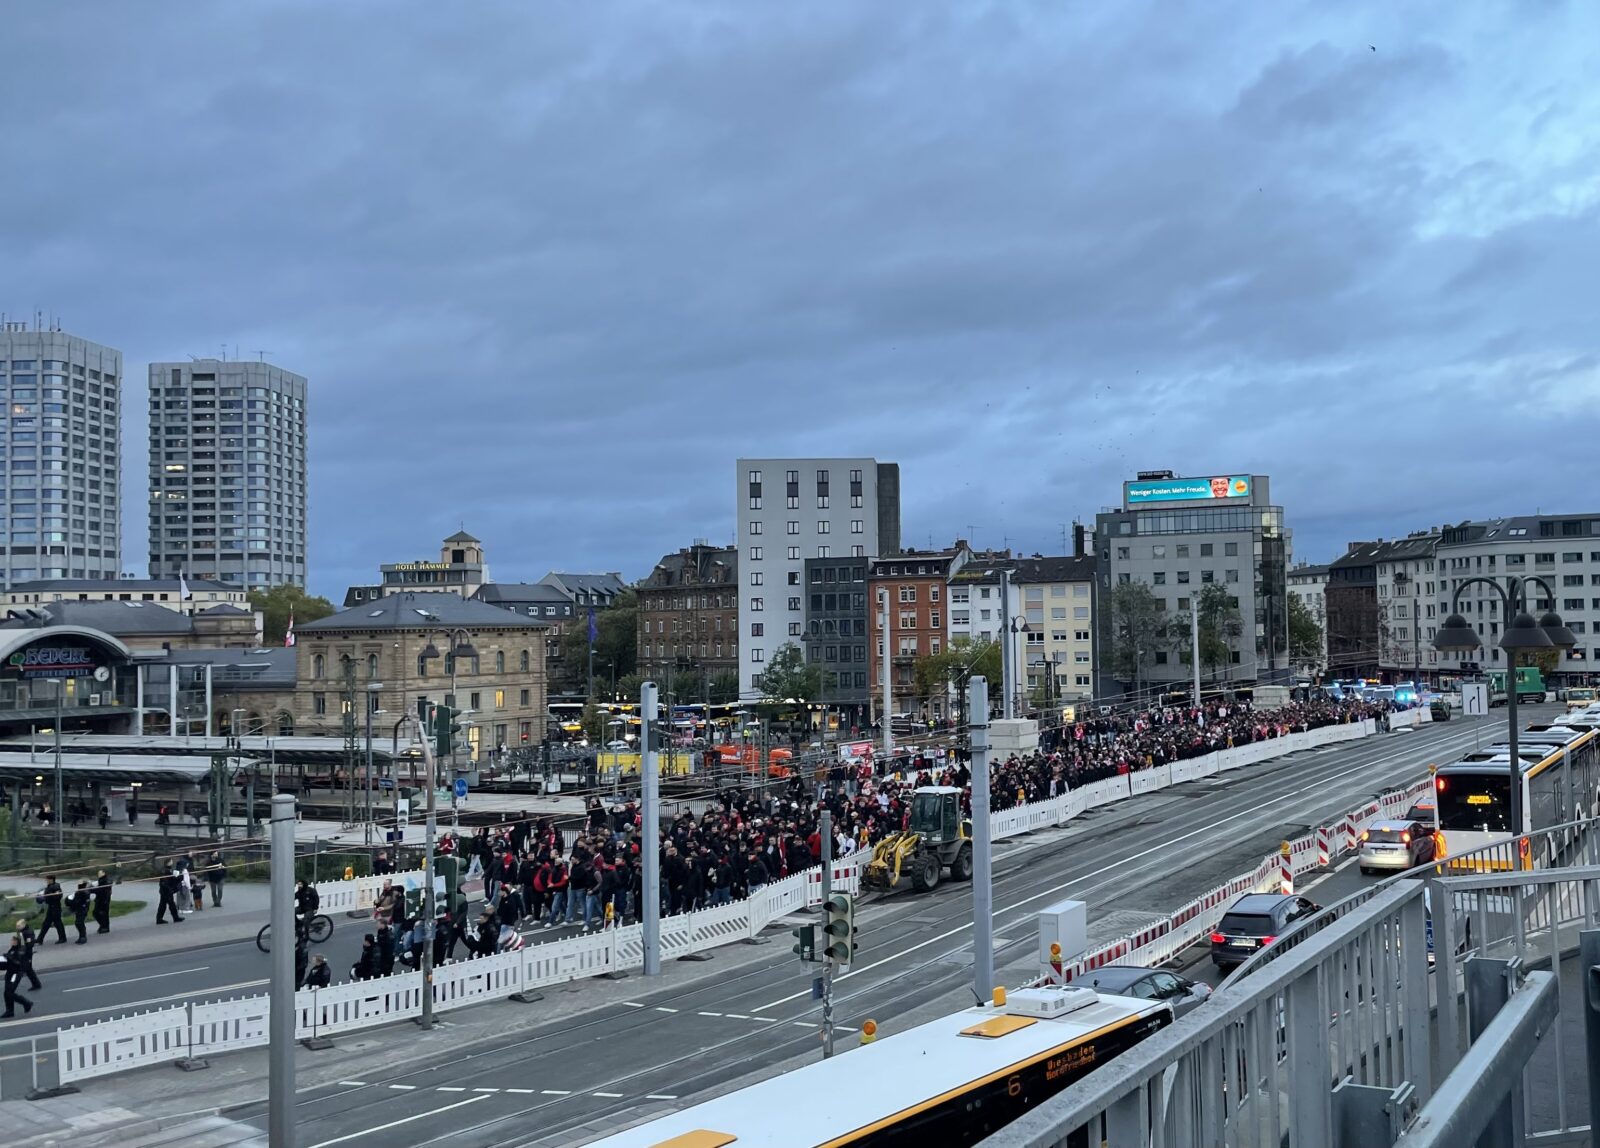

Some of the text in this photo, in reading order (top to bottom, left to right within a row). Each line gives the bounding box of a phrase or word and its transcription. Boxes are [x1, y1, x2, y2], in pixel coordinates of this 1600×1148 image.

[1130, 489, 1151, 497] Weniger
[1186, 485, 1207, 493] Freude.
[1007, 1073, 1021, 1096] 6
